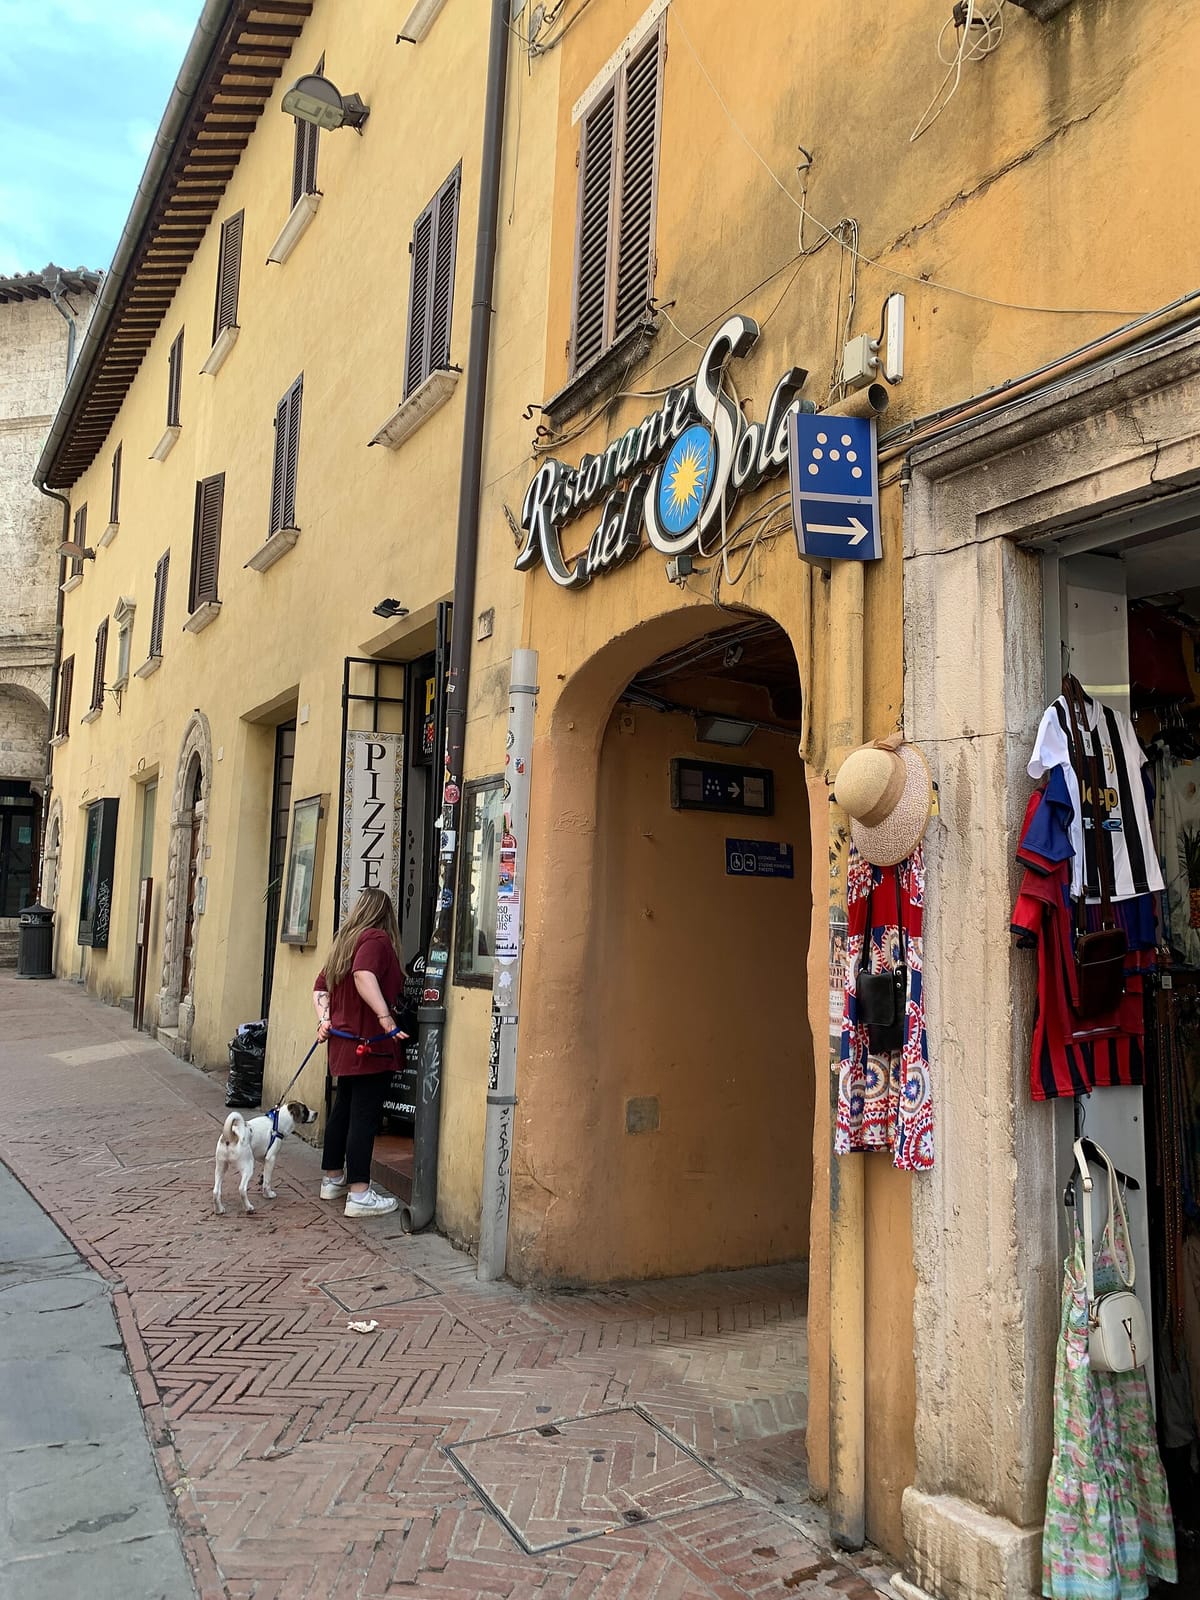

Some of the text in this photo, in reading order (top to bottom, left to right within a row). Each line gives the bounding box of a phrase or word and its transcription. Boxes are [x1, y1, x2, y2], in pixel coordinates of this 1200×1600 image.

[515, 387, 695, 589] Ristorante
[588, 315, 815, 573] del Sole
[361, 742, 387, 890] PIZZE
